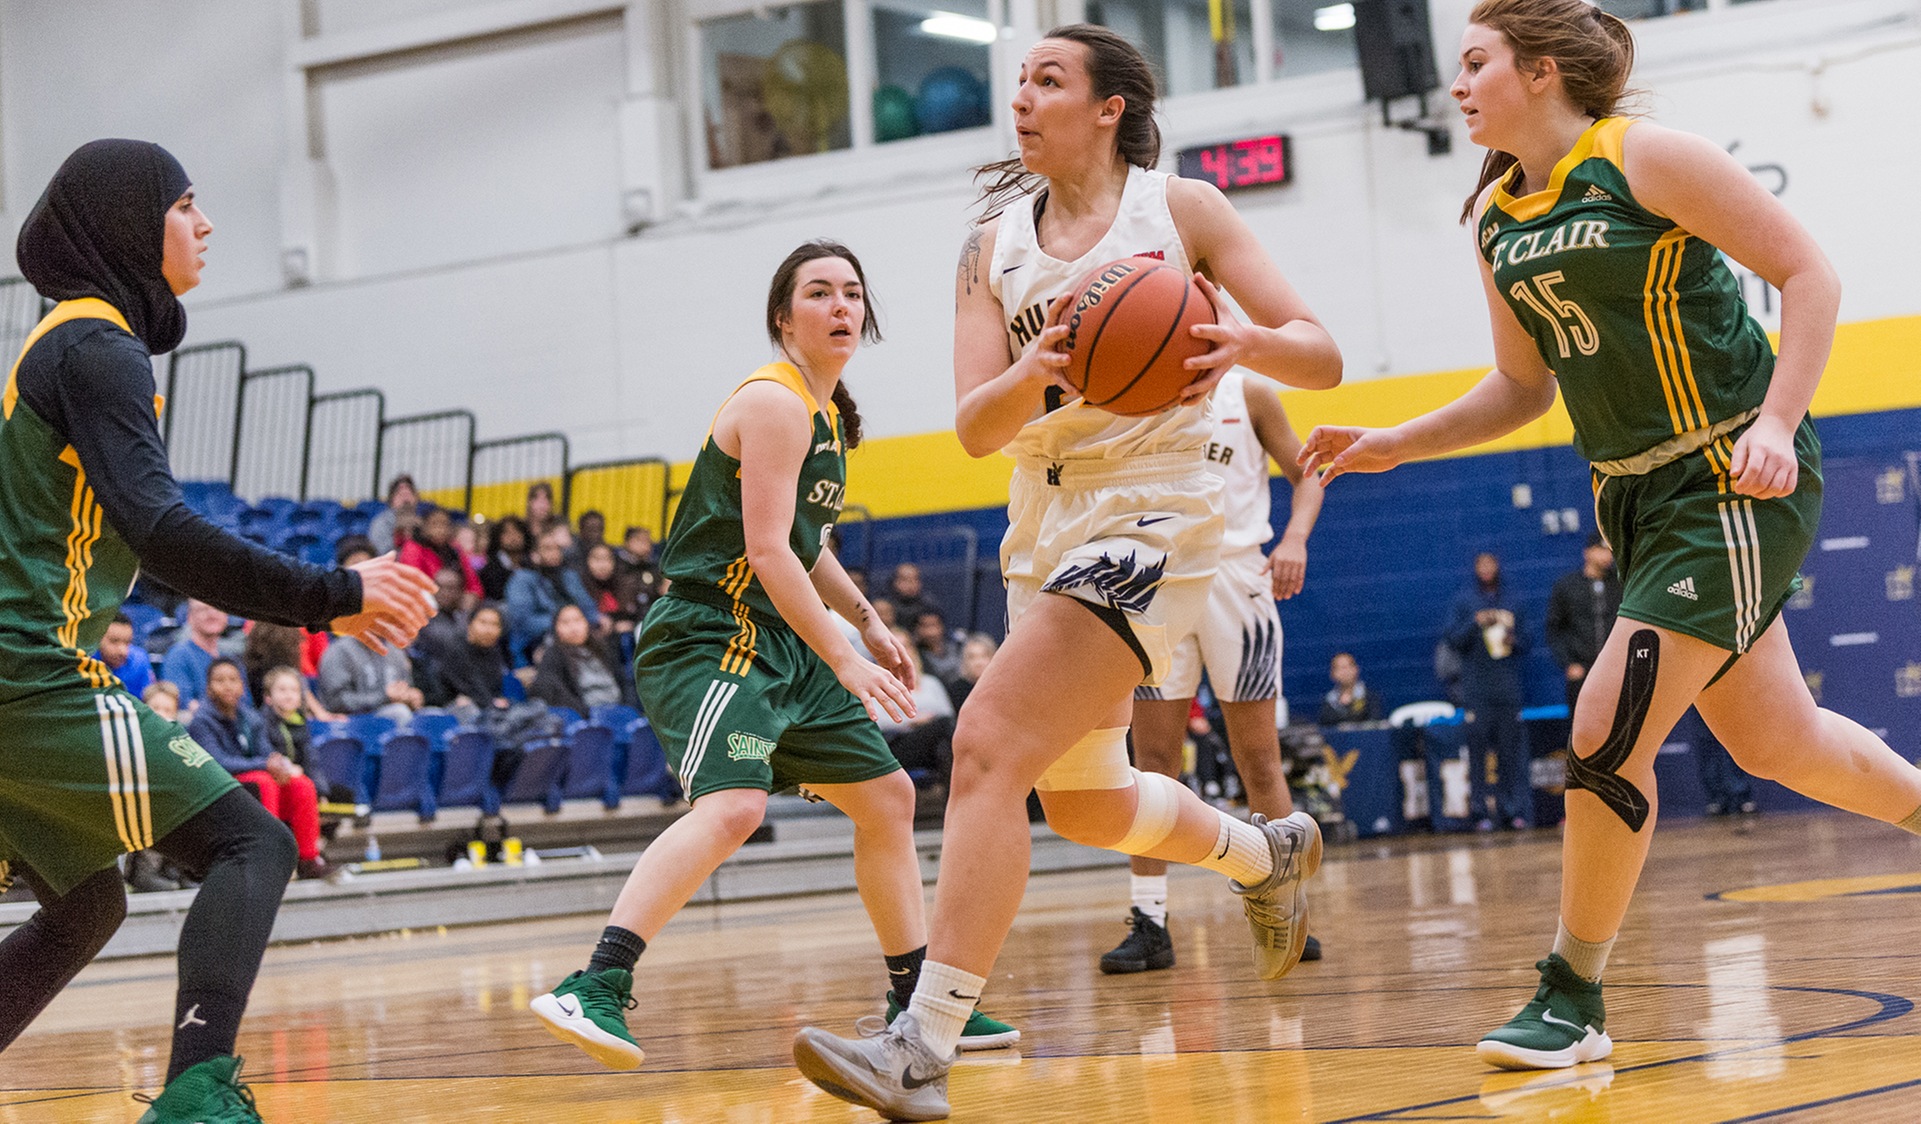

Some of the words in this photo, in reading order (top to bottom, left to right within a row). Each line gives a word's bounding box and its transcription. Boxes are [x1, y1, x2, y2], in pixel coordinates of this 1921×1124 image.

[1582, 193, 1613, 204] adidas
[1492, 240, 1509, 273] T.
[1507, 219, 1610, 266] CLAIR
[1509, 270, 1600, 358] 15
[1203, 442, 1234, 466] ER
[1666, 586, 1699, 602] adidas
[1636, 648, 1650, 659] KT
